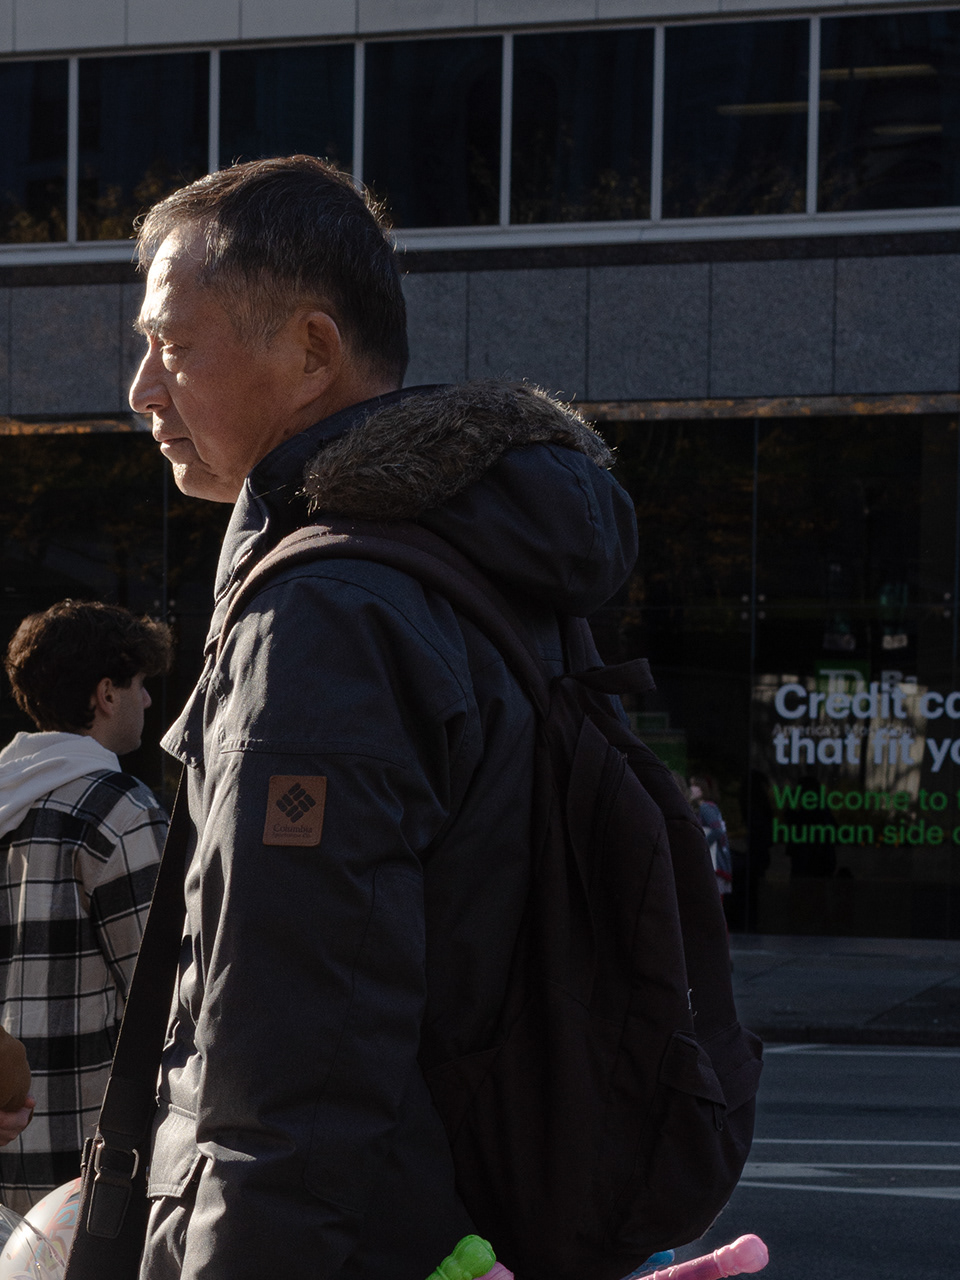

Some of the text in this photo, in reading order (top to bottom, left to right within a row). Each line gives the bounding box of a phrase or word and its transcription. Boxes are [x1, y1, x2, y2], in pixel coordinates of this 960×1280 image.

[774, 681, 908, 720] Credit
[773, 728, 861, 765] that
[872, 728, 916, 765] fit
[773, 784, 911, 811] Welcome
[918, 788, 948, 811] to
[273, 823, 313, 834] Columbia
[772, 818, 874, 844] human
[883, 819, 944, 845] side
